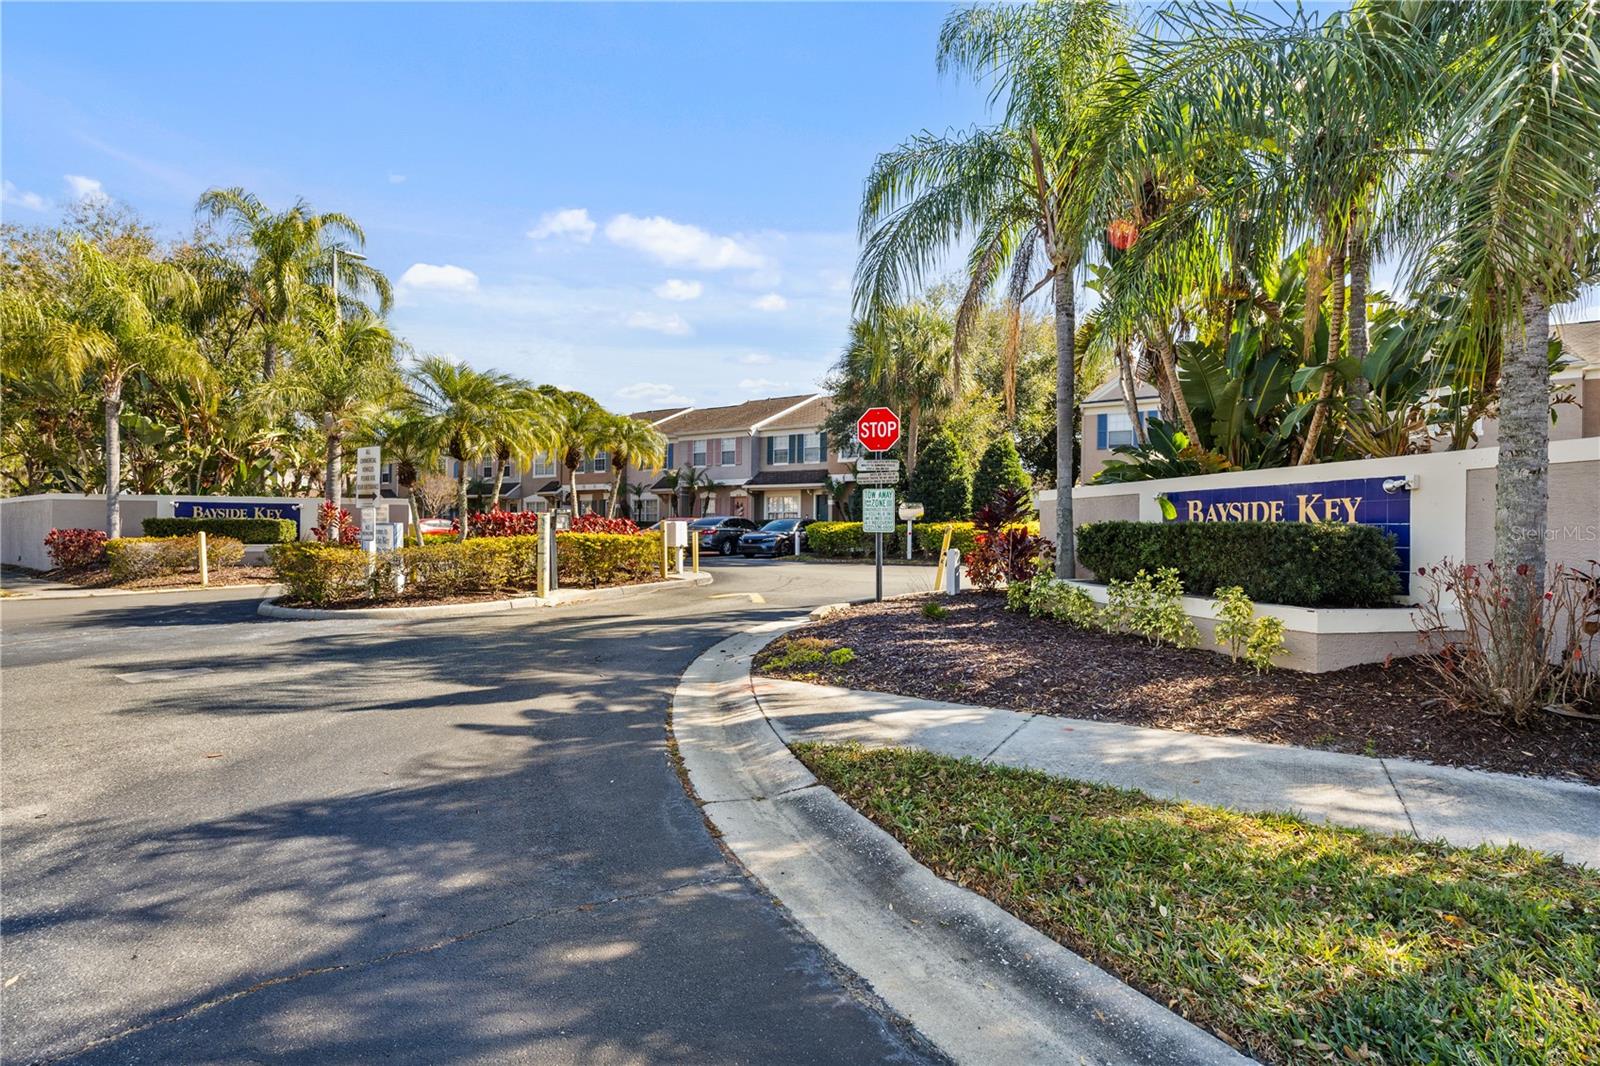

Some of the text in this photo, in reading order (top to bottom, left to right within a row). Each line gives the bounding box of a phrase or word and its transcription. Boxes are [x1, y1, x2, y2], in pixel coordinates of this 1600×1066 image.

[861, 421, 897, 438] STOP
[878, 491, 892, 499] AWAY
[871, 499, 887, 507] ZONE
[1187, 493, 1363, 524] BAYSIDE KEY
[192, 506, 283, 519] BAYSIDE KEY
